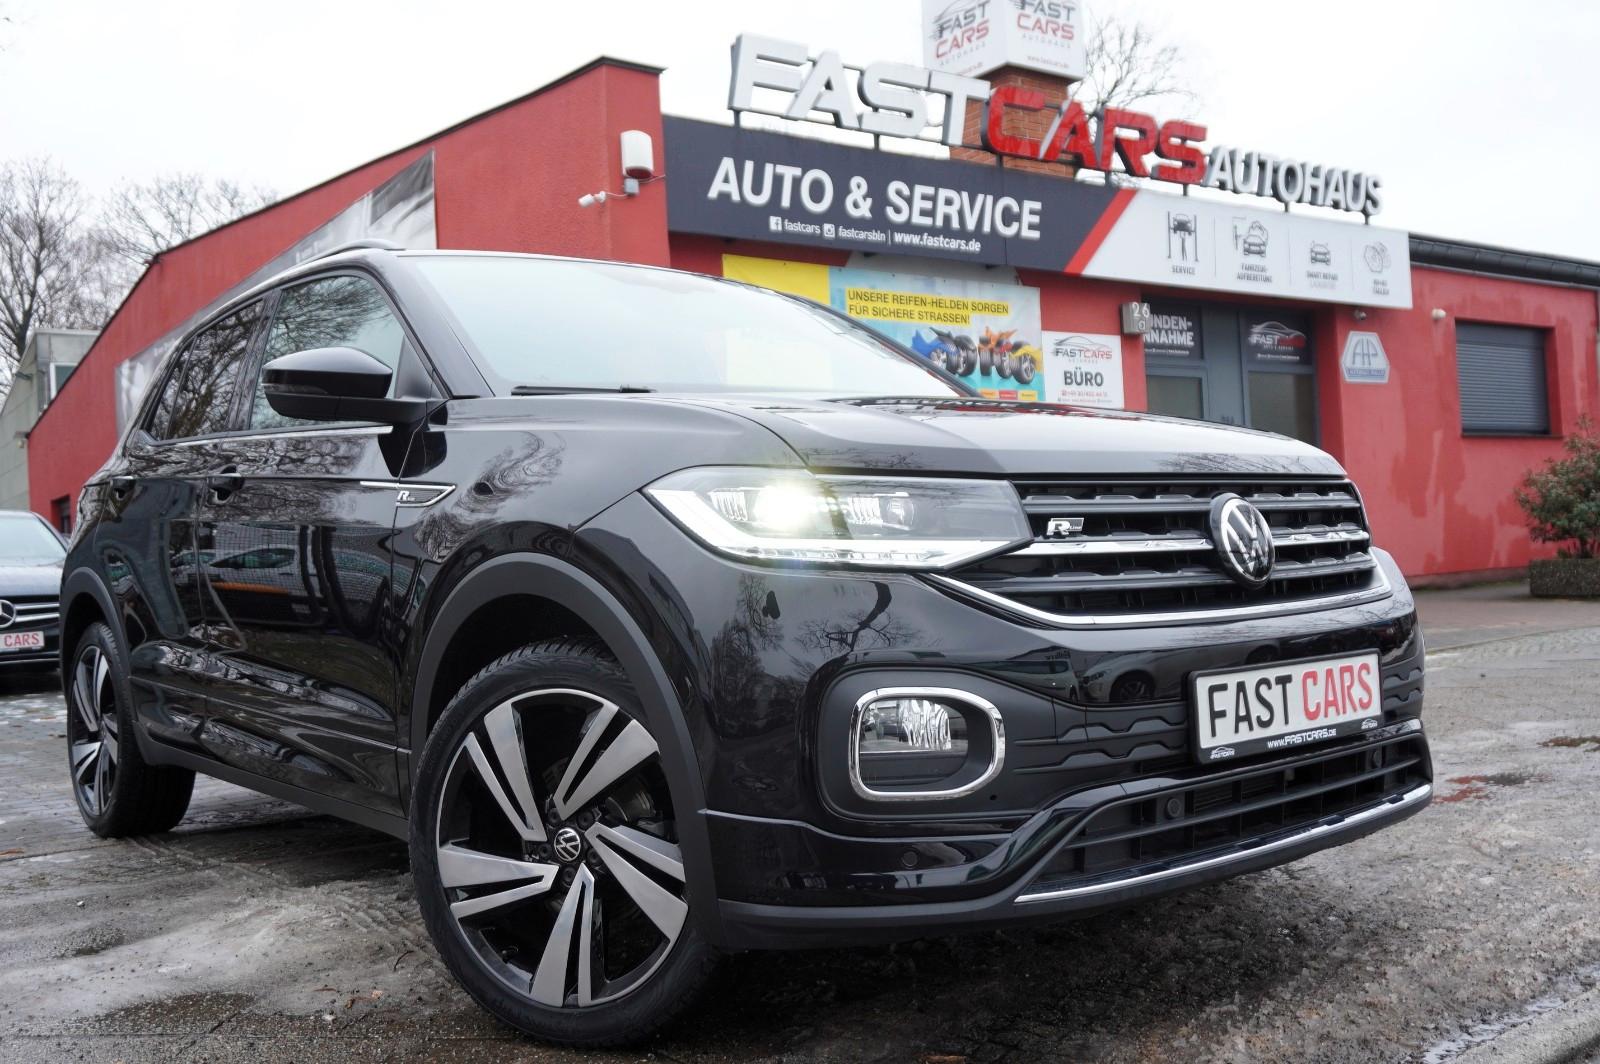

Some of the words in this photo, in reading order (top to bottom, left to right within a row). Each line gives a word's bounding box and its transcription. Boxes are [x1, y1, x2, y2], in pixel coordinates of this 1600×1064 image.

[938, 0, 991, 38] FAST
[1017, 12, 1075, 40] CARS
[935, 19, 990, 58] CARS
[1203, 145, 1383, 215] AUTOHAUS
[707, 156, 834, 213] AUTO
[845, 176, 873, 218] &
[885, 180, 1042, 240] SERVICE
[783, 219, 821, 234] fastcars
[838, 226, 886, 242] fastcarsbln
[894, 231, 981, 251] www.fastcars.de
[848, 289, 889, 304] UNSERE
[892, 295, 968, 311] REIFEN-HELDEN
[971, 302, 1009, 314] SORGEN
[848, 303, 869, 315] FÜR
[872, 306, 915, 320] SICHERE
[918, 310, 970, 325] STRASSEN!
[1131, 301, 1150, 318] 26
[1054, 347, 1112, 360] FASTCARS
[1063, 366, 1104, 387] BÜRO
[3, 632, 40, 648] CARS
[1207, 674, 1293, 738] FAST
[1302, 662, 1373, 721] CARS
